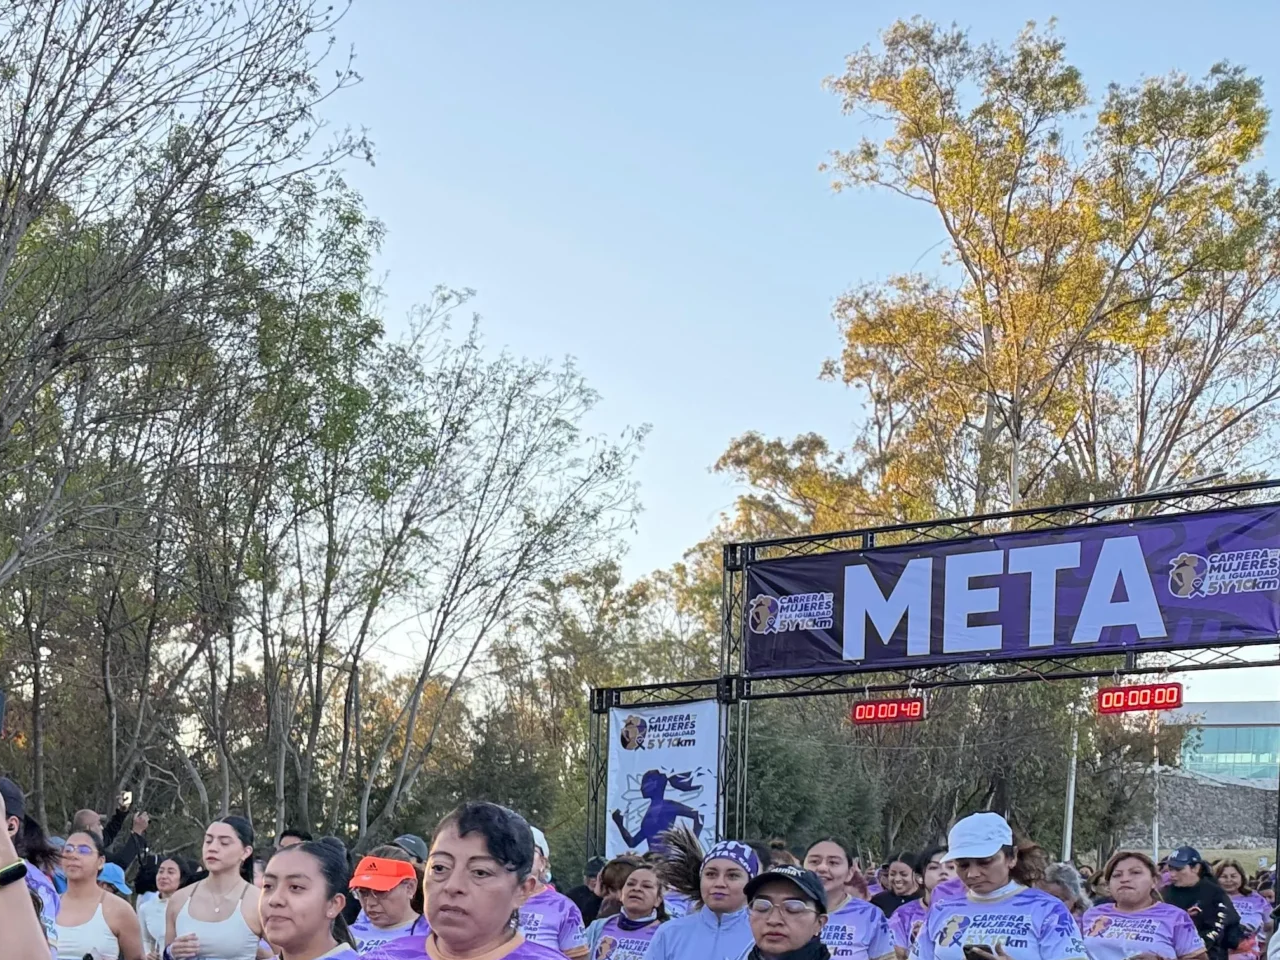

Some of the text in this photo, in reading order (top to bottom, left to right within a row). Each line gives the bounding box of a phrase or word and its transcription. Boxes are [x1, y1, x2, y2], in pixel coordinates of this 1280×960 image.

[1209, 549, 1269, 563] CARRERA
[1209, 558, 1278, 574] MUJERES
[1228, 569, 1278, 580] IGUALDAD
[780, 594, 825, 604] CARRERA
[842, 535, 1168, 661] META
[780, 601, 832, 613] MUJERES
[794, 610, 832, 618] IGUALDAD
[1101, 687, 1178, 709] 00:00:00
[648, 714, 691, 724] CARRERA
[648, 720, 696, 732] MUJERES
[662, 730, 696, 738] IGUALDAD
[647, 740, 655, 750] 5
[658, 739, 666, 748] Y
[972, 914, 1024, 922] CARRERA
[970, 920, 1032, 931] MUJERES
[1111, 922, 1158, 931] MUJERES
[985, 928, 1028, 936] IGUALDAD
[619, 938, 650, 946] CARRER
[617, 944, 648, 952] MUJER
